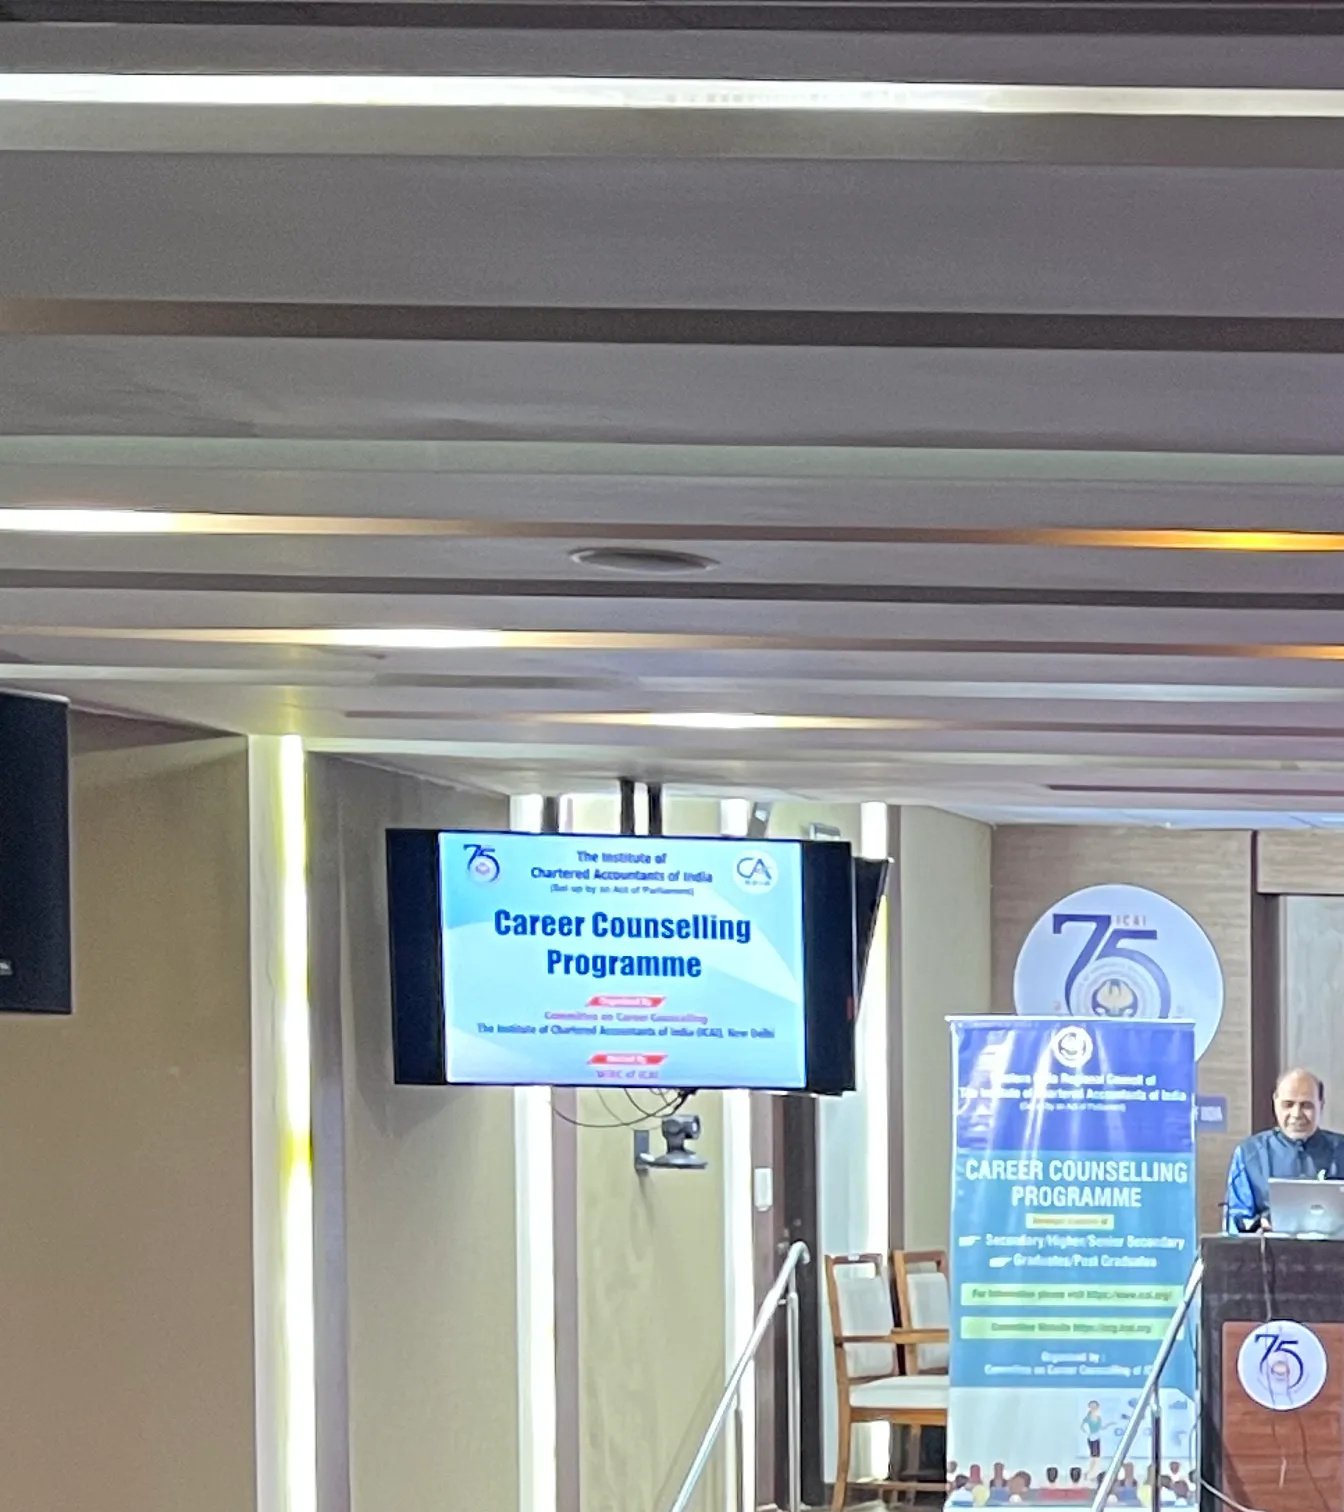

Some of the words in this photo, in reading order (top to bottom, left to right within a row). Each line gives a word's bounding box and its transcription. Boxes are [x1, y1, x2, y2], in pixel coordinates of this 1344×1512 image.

[577, 851, 597, 862] The
[602, 852, 651, 863] Institute
[655, 852, 666, 863] of
[531, 867, 589, 880] Chartered
[595, 869, 664, 881] Accountants
[668, 871, 679, 881] of
[684, 871, 713, 883] India
[494, 909, 585, 937] Career
[592, 912, 751, 943] Counselling
[548, 950, 702, 978] Programme
[965, 1160, 1043, 1181] CAREER
[1050, 1161, 1187, 1183] COUNSELLING
[1012, 1187, 1142, 1207] PROGRAMME
[1255, 1334, 1303, 1389] 75
